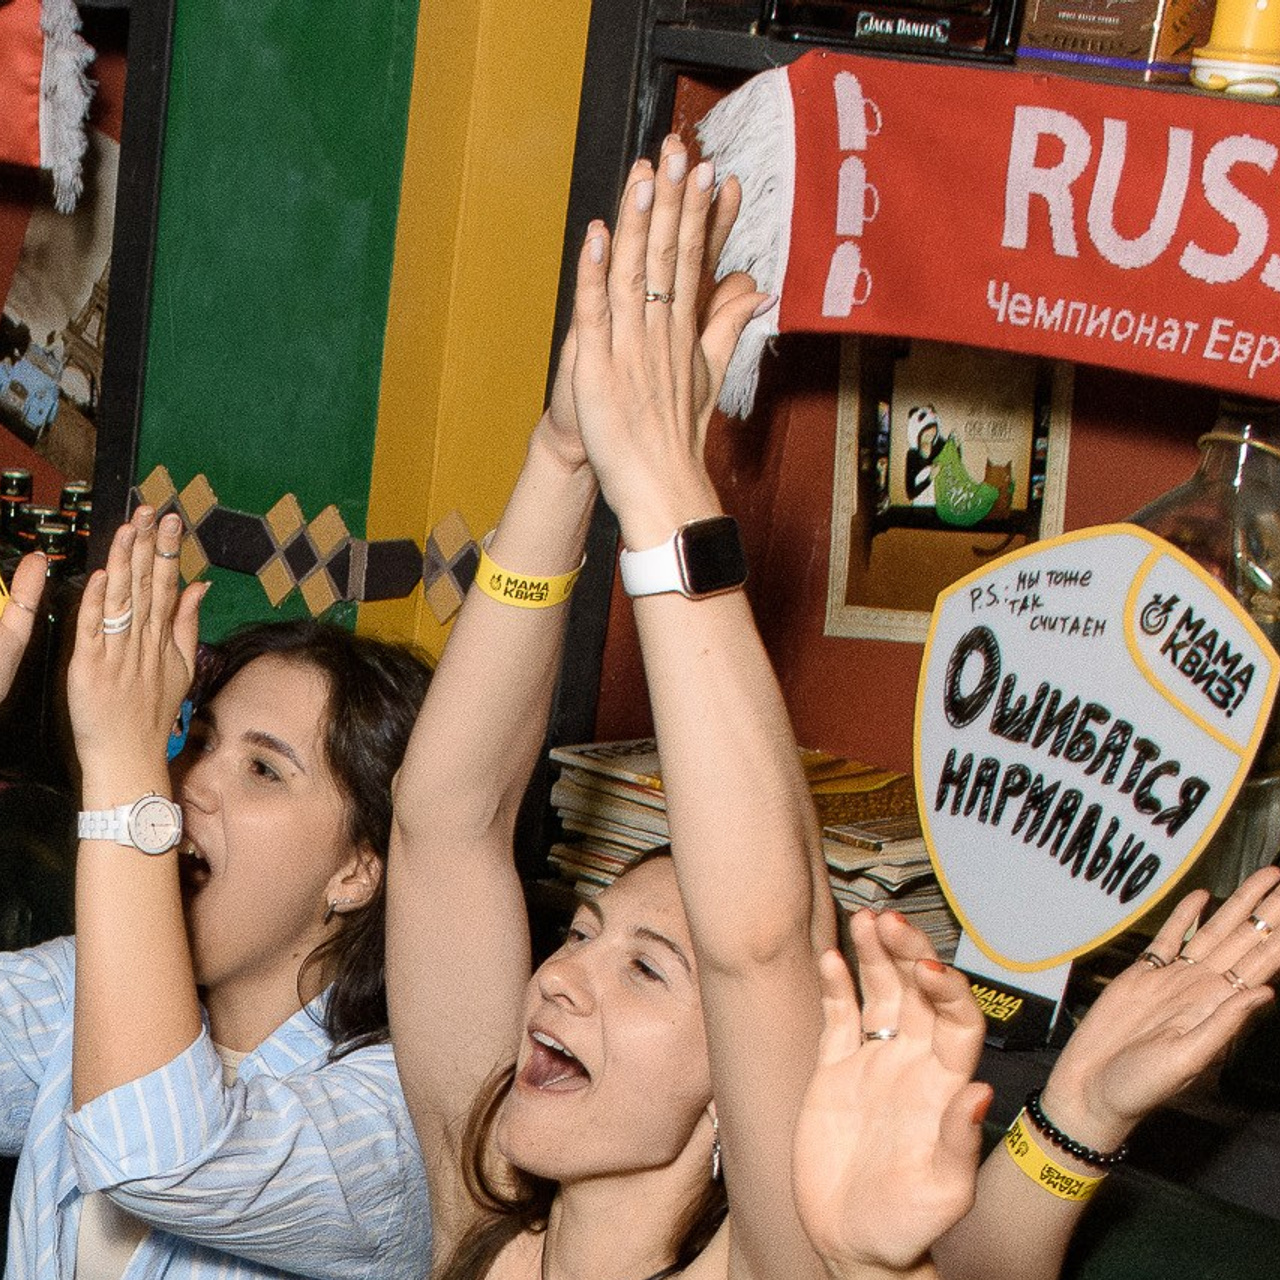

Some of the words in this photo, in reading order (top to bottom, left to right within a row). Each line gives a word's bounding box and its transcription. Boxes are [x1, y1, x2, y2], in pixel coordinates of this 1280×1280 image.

[1001, 105, 1280, 292] RUS
[986, 279, 1200, 355] Чемпионат
[503, 588, 549, 601] КВИЗ!
[505, 577, 550, 592] МАМА
[1160, 631, 1245, 718] КВИЗ!
[1176, 606, 1256, 695] МАМА
[935, 748, 1161, 904] НАРМАЛЬНО
